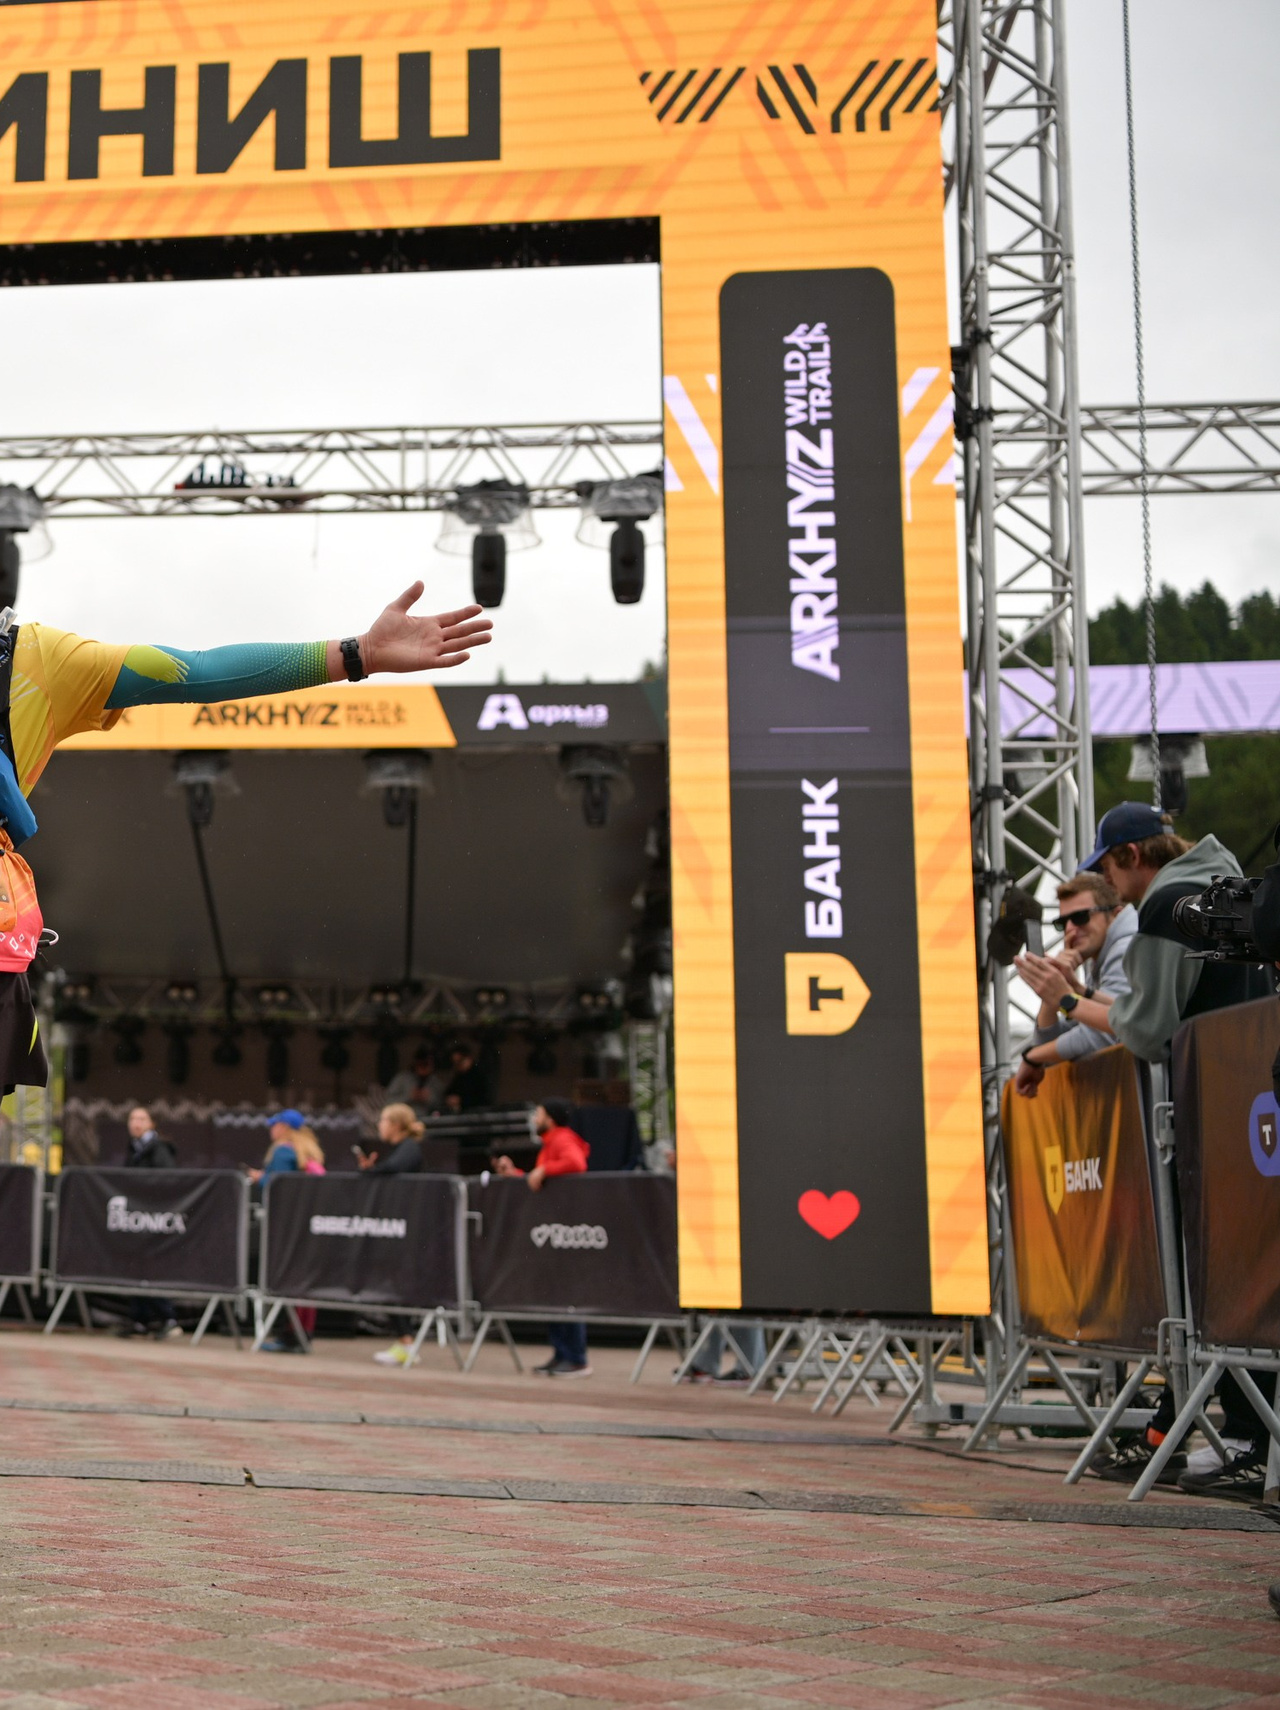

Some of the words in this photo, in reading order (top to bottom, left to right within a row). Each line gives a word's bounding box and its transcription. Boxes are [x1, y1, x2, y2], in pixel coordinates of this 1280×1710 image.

[783, 349, 809, 427] WILD
[807, 342, 833, 426] TRAIL
[785, 428, 841, 682] ARKHYZ
[192, 703, 340, 726] ARKHYZ
[801, 777, 843, 938] БАНК
[1064, 1156, 1103, 1193] БАНК
